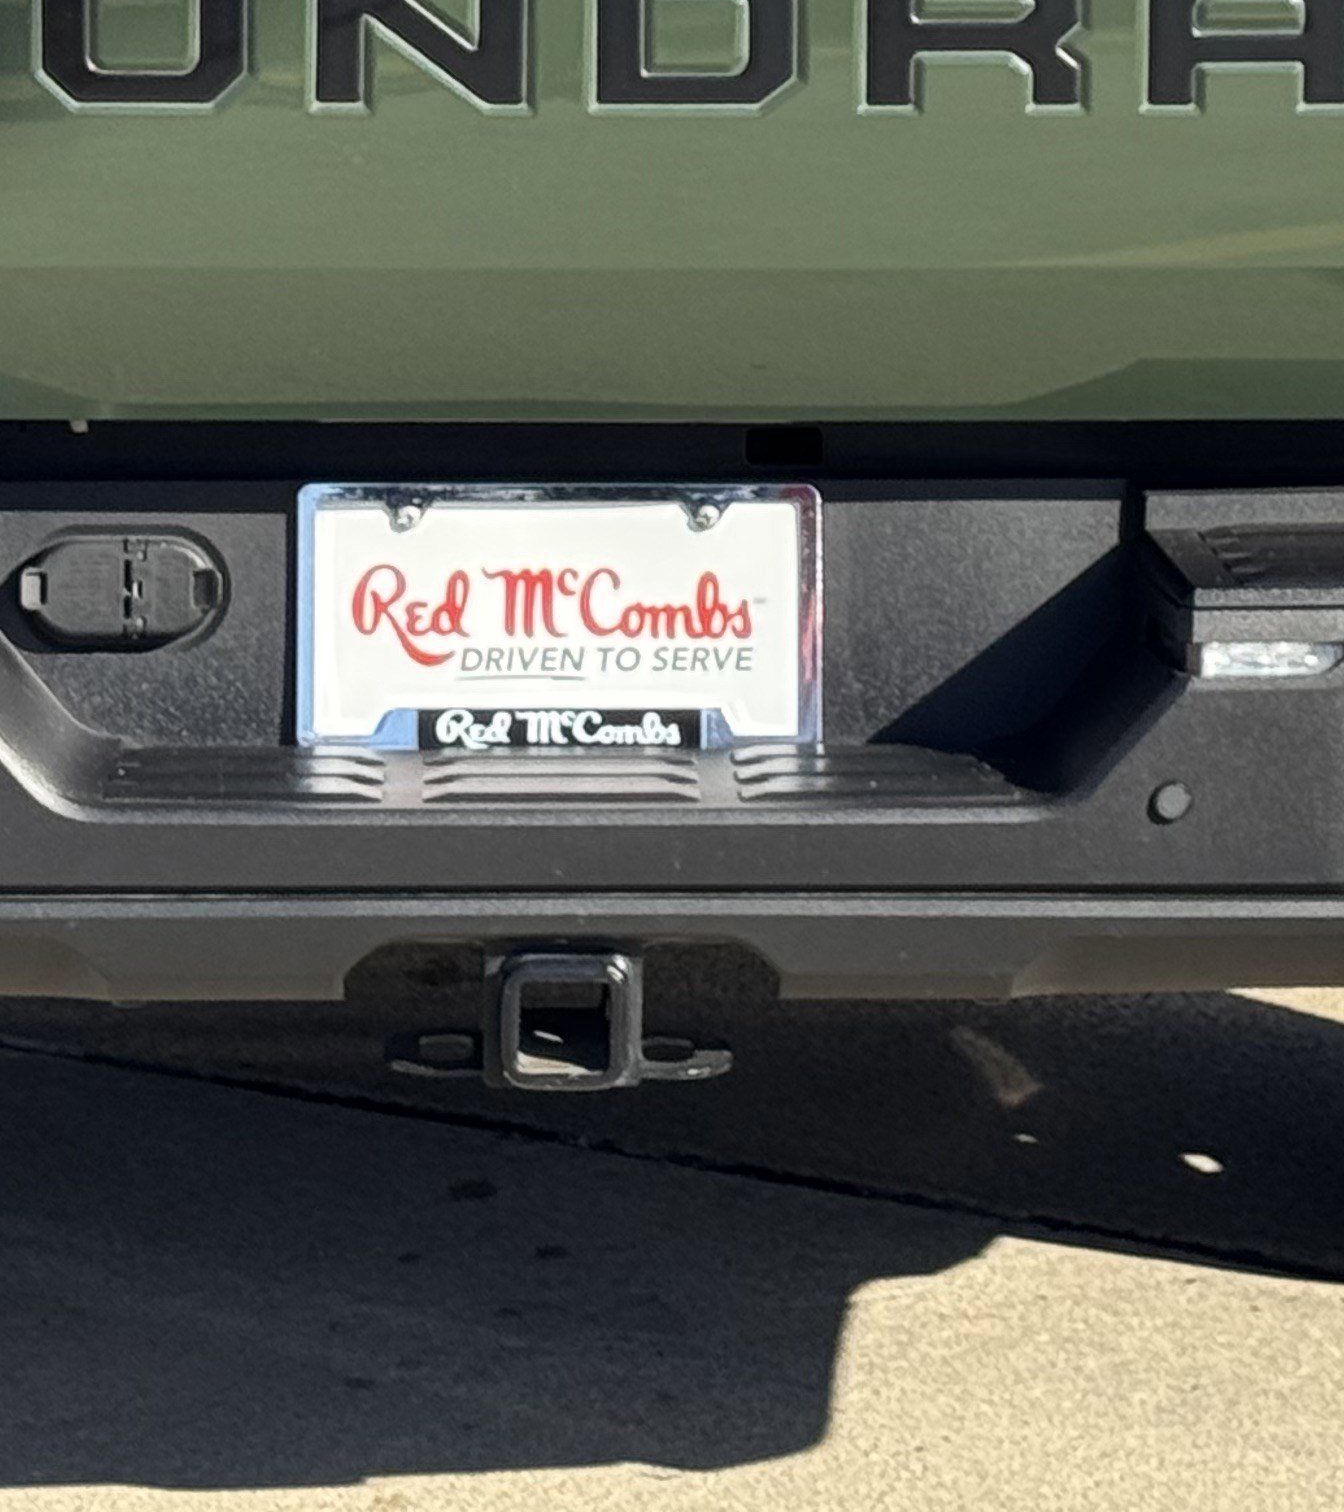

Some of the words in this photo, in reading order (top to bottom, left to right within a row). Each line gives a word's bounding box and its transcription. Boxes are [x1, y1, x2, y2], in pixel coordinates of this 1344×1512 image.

[352, 564, 472, 667] Red
[482, 567, 753, 639] McCombs
[460, 646, 586, 673] DRIVEN
[596, 646, 642, 673] TO
[652, 646, 755, 673] SERVE
[435, 708, 513, 749] Red
[514, 710, 682, 746] McCombs
